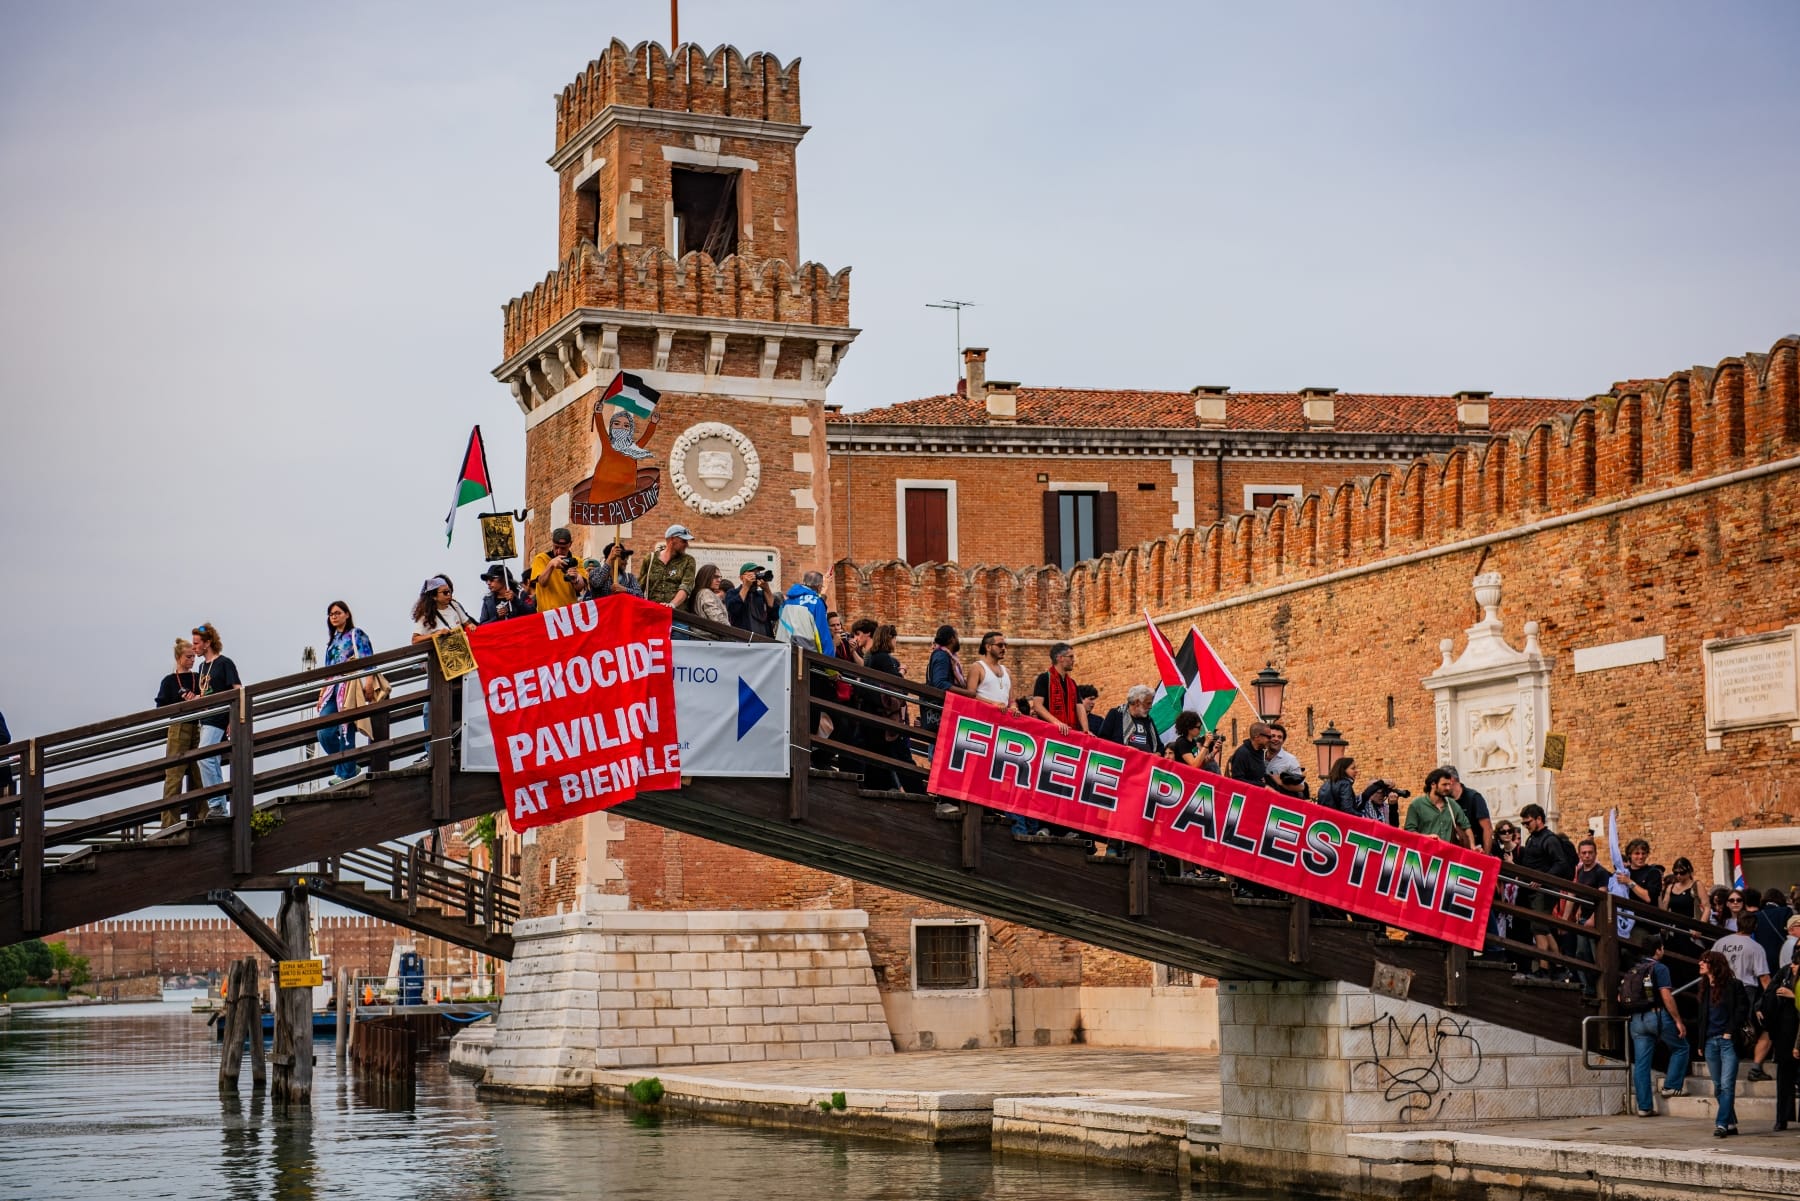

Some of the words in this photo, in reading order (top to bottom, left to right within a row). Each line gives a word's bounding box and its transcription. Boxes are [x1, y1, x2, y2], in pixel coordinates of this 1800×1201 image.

[574, 502, 605, 525] FREE
[608, 482, 659, 524] PALESTINE
[488, 638, 666, 714] GENOCIDE
[673, 667, 718, 683] TICO
[514, 780, 549, 820] AT
[948, 715, 1126, 812] FREE
[1142, 765, 1484, 923] PALESTINE
